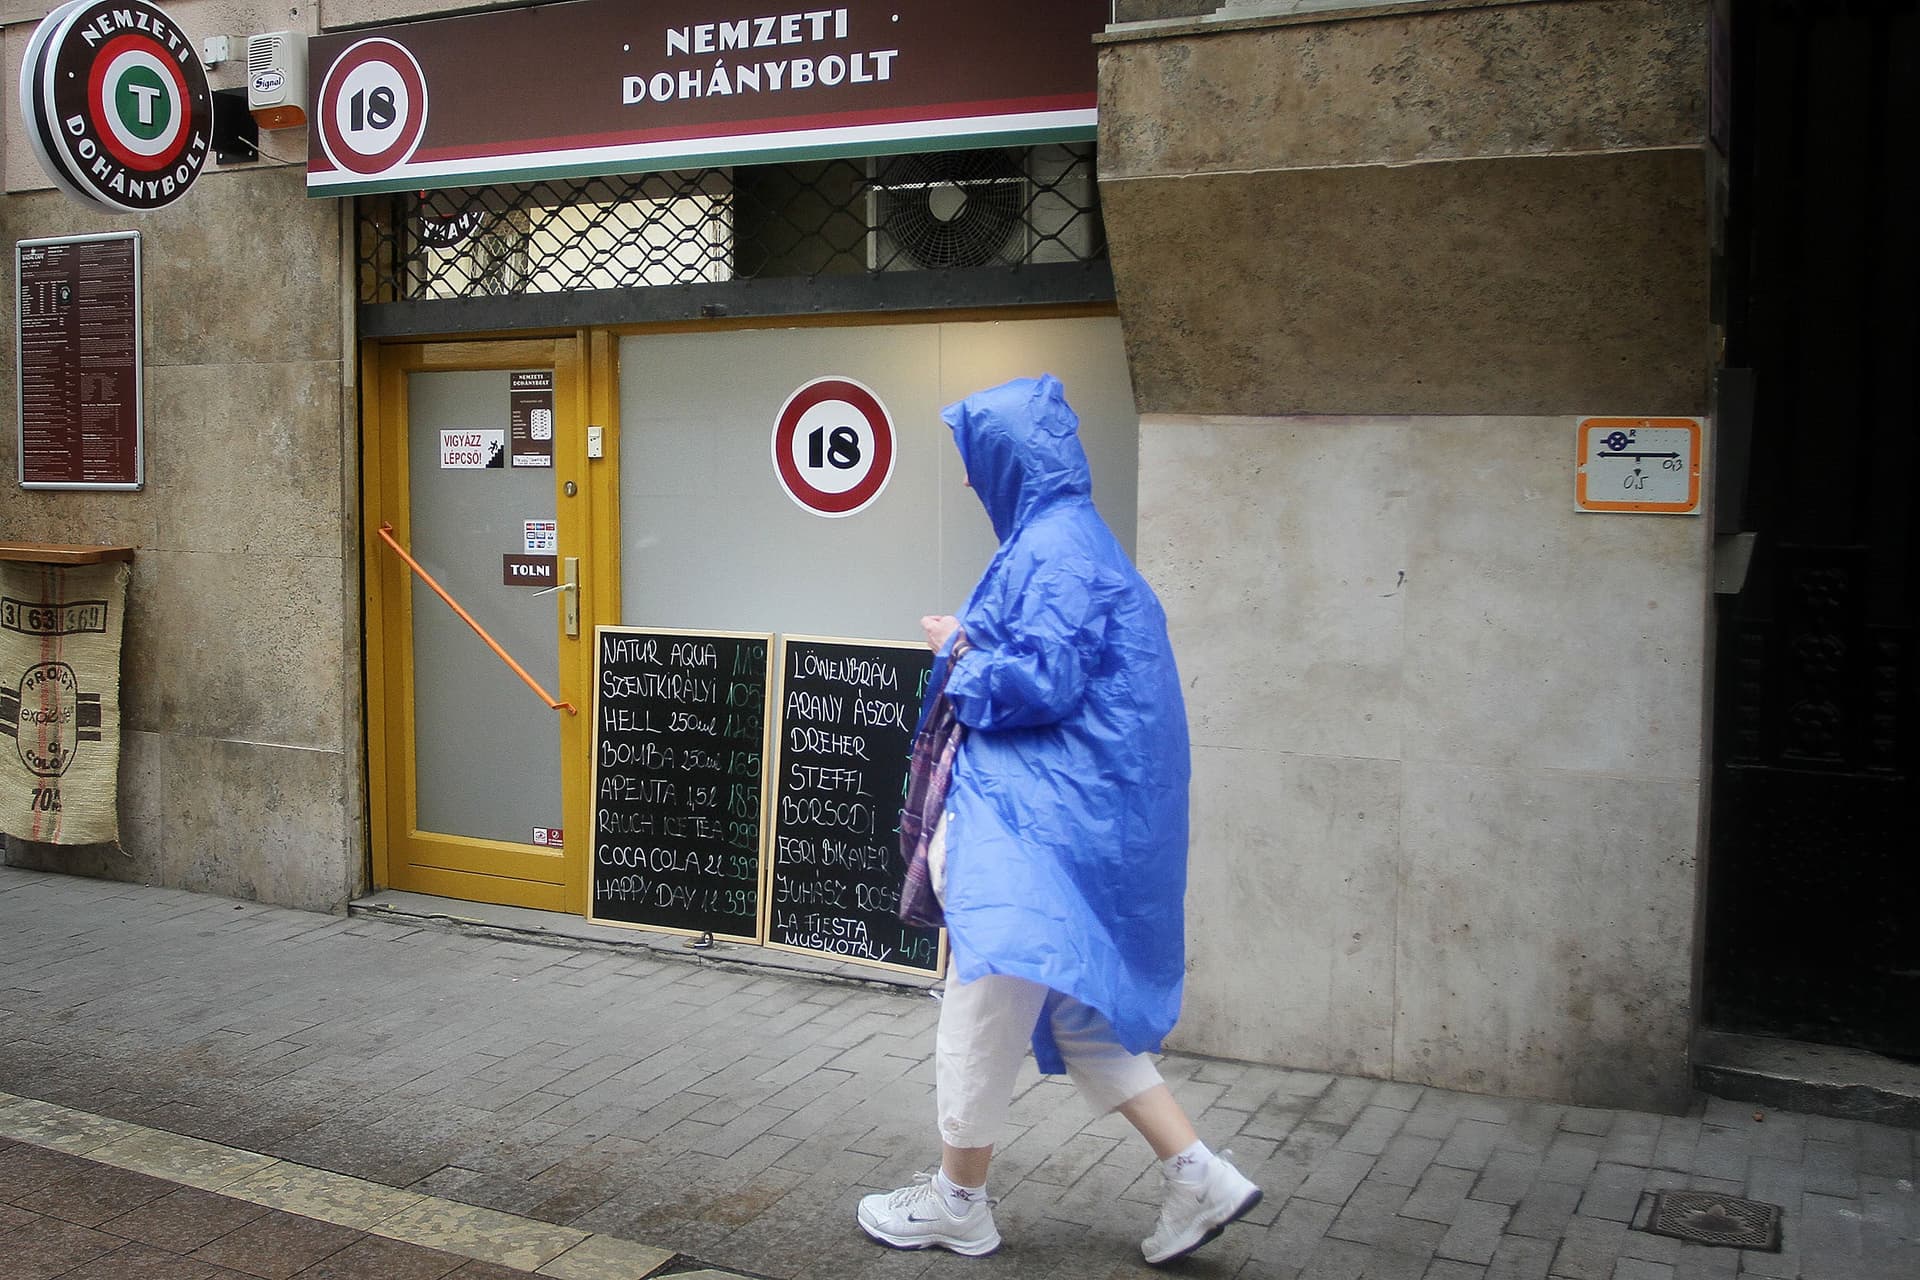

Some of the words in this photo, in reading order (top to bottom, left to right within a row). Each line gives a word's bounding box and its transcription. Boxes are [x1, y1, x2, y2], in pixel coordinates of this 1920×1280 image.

[81, 9, 190, 62] NEMZETI
[667, 8, 848, 56] NEMZETI
[255, 77, 283, 90] Signal
[622, 50, 899, 105] DOHÁNYBOLT
[128, 84, 161, 125] T
[350, 86, 397, 132] 18
[66, 114, 206, 199] DOHÁNYBOLT
[444, 431, 482, 447] VIGYÁZZ
[808, 425, 862, 470] 18
[510, 564, 550, 577] TOLNI
[604, 637, 663, 666] NATUR
[670, 643, 717, 670] AQUA
[794, 650, 898, 690] LÖWENBRÄU
[604, 706, 662, 733] HELL
[786, 691, 843, 724] ARANY
[853, 688, 909, 732] ÁSZOK
[601, 740, 675, 770] BOMBA
[727, 751, 762, 777] 165
[790, 727, 870, 761] DREHER
[601, 775, 676, 806] APENTA
[727, 783, 760, 818] 185
[789, 763, 873, 797] STEFFL
[599, 808, 654, 835] RAUCH
[598, 844, 647, 868] COCA
[650, 848, 701, 875] COLA
[596, 874, 652, 904] HAPPY
[654, 883, 697, 911] DAY
[777, 909, 798, 930] LA
[804, 913, 867, 942] FIESTA
